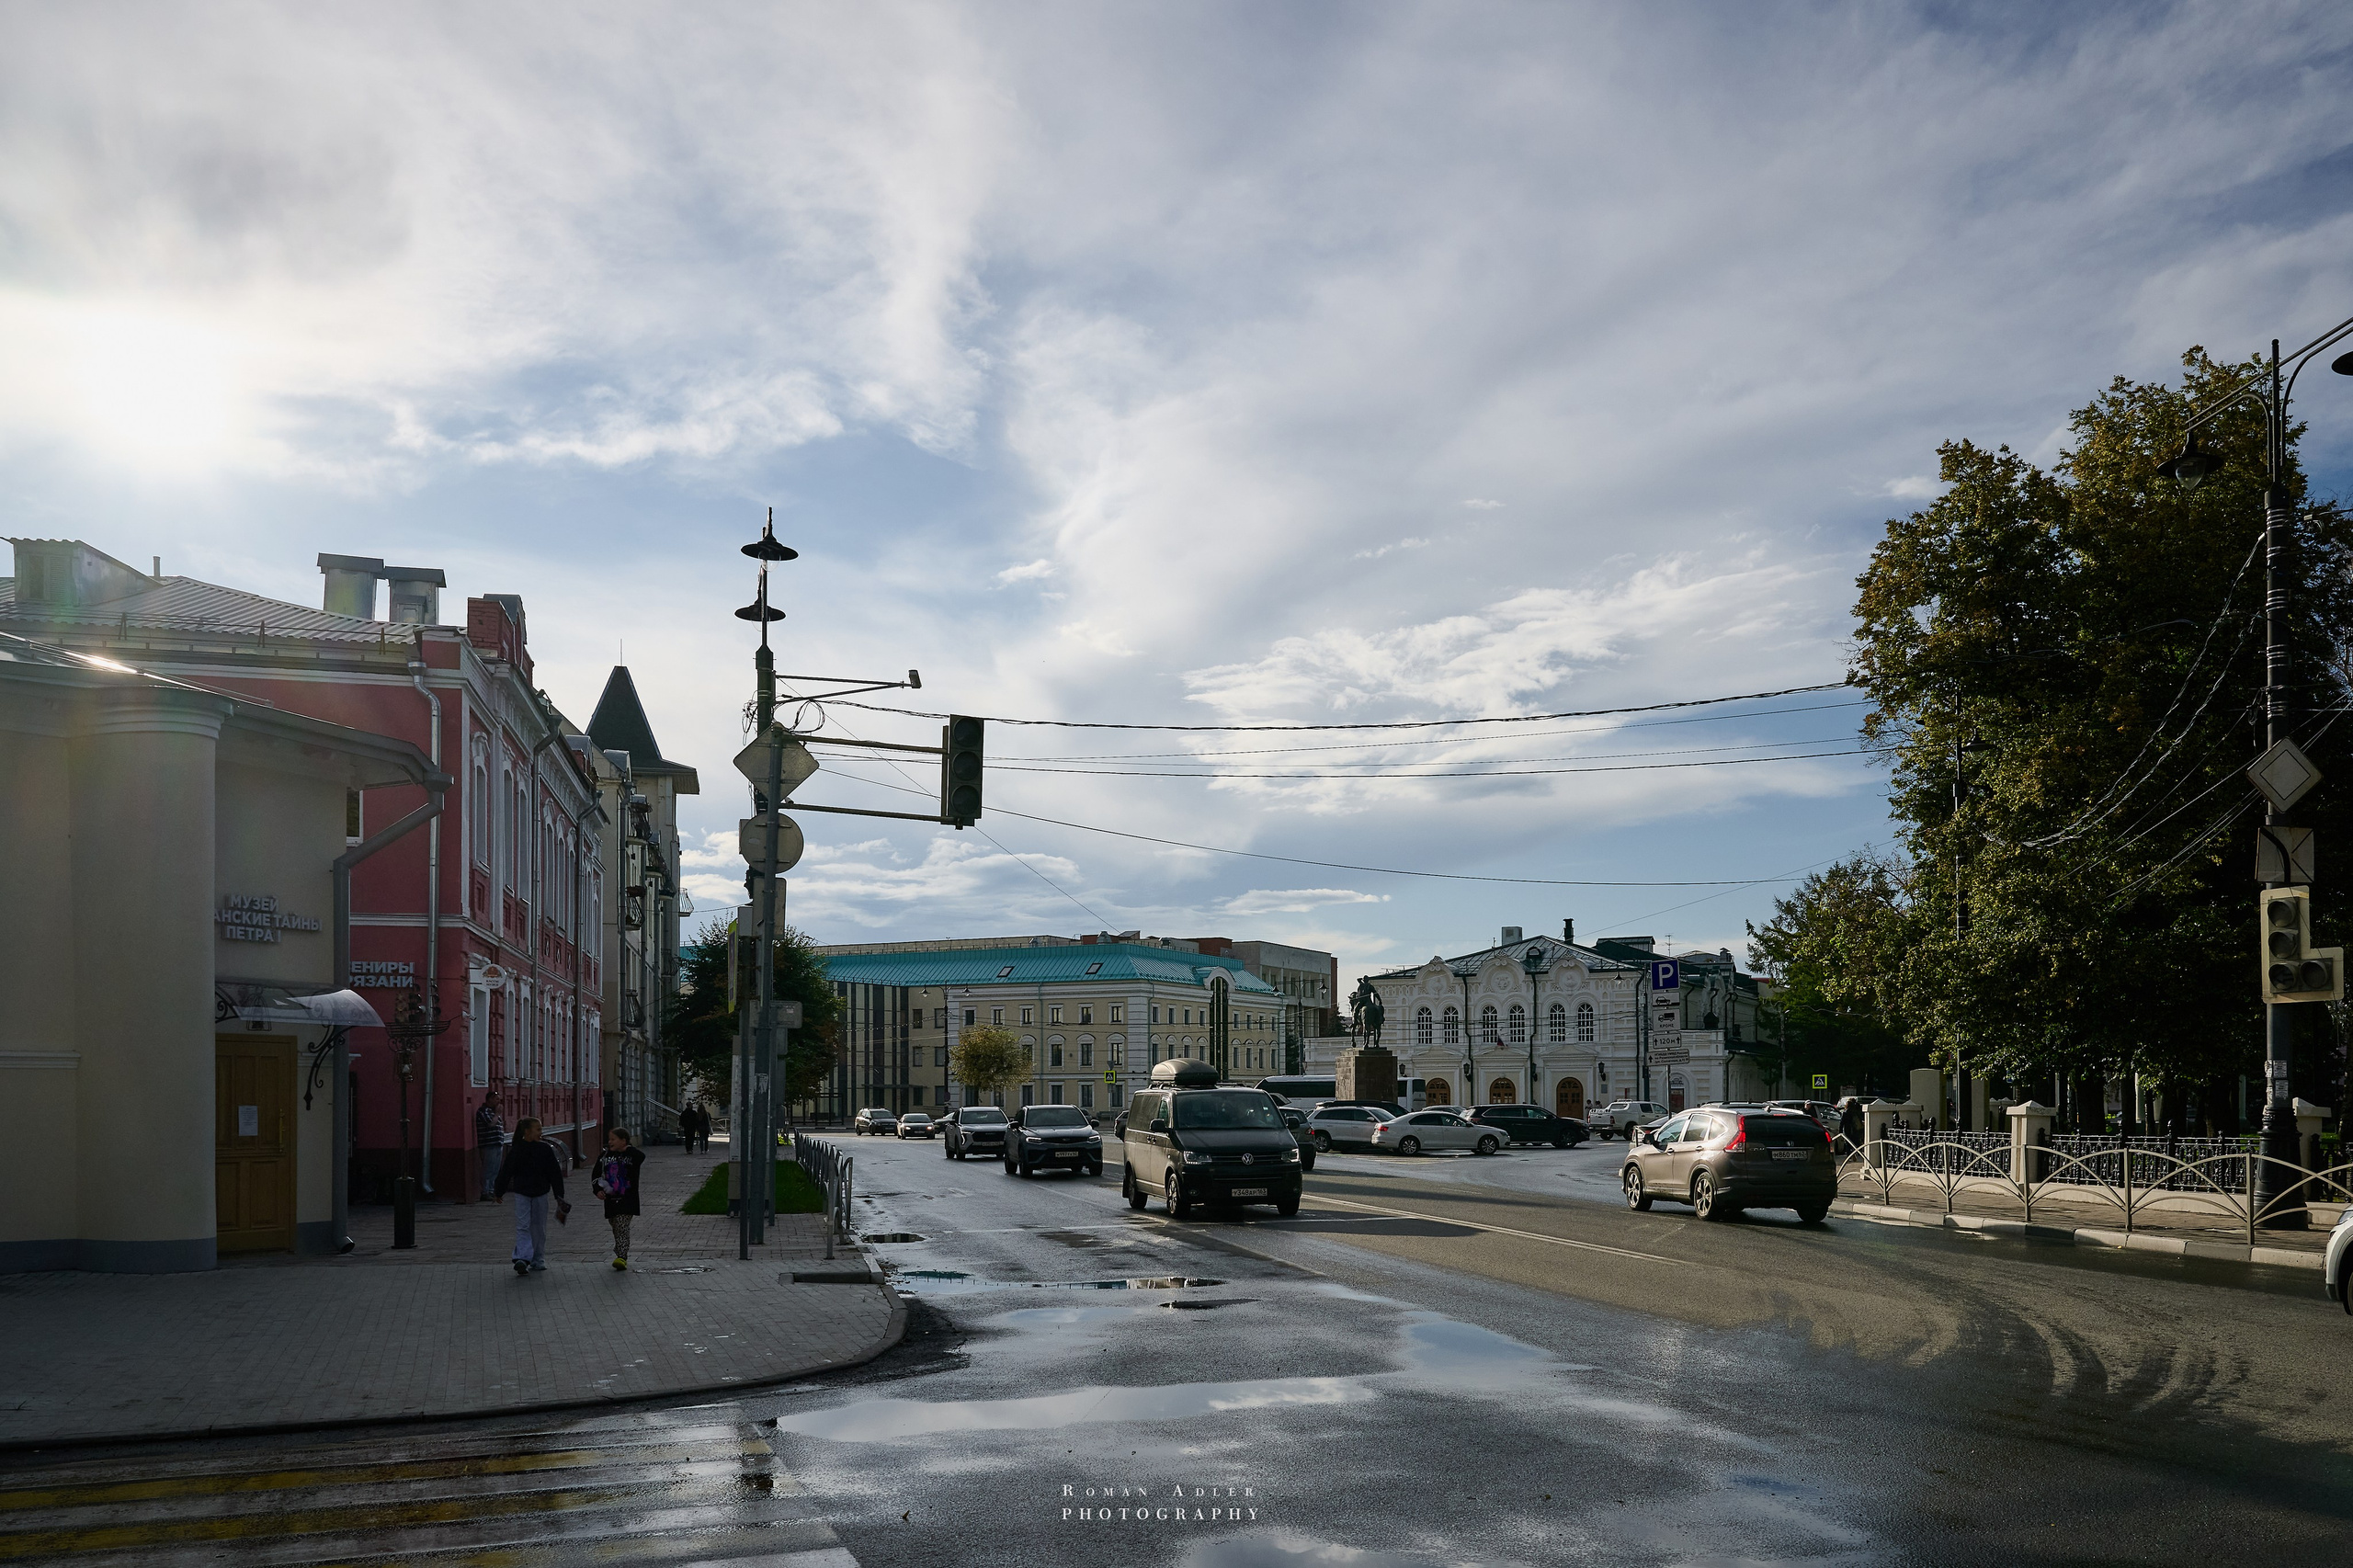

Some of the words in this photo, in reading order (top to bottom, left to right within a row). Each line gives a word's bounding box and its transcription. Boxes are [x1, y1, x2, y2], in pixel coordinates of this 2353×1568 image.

[230, 894, 279, 912] МУЗЕЙ
[213, 909, 271, 926] АНСКИЕ
[273, 912, 322, 931] ТАЙНЫ
[226, 925, 275, 942] ПЕТРА
[350, 960, 415, 974] ЕНИРЫ
